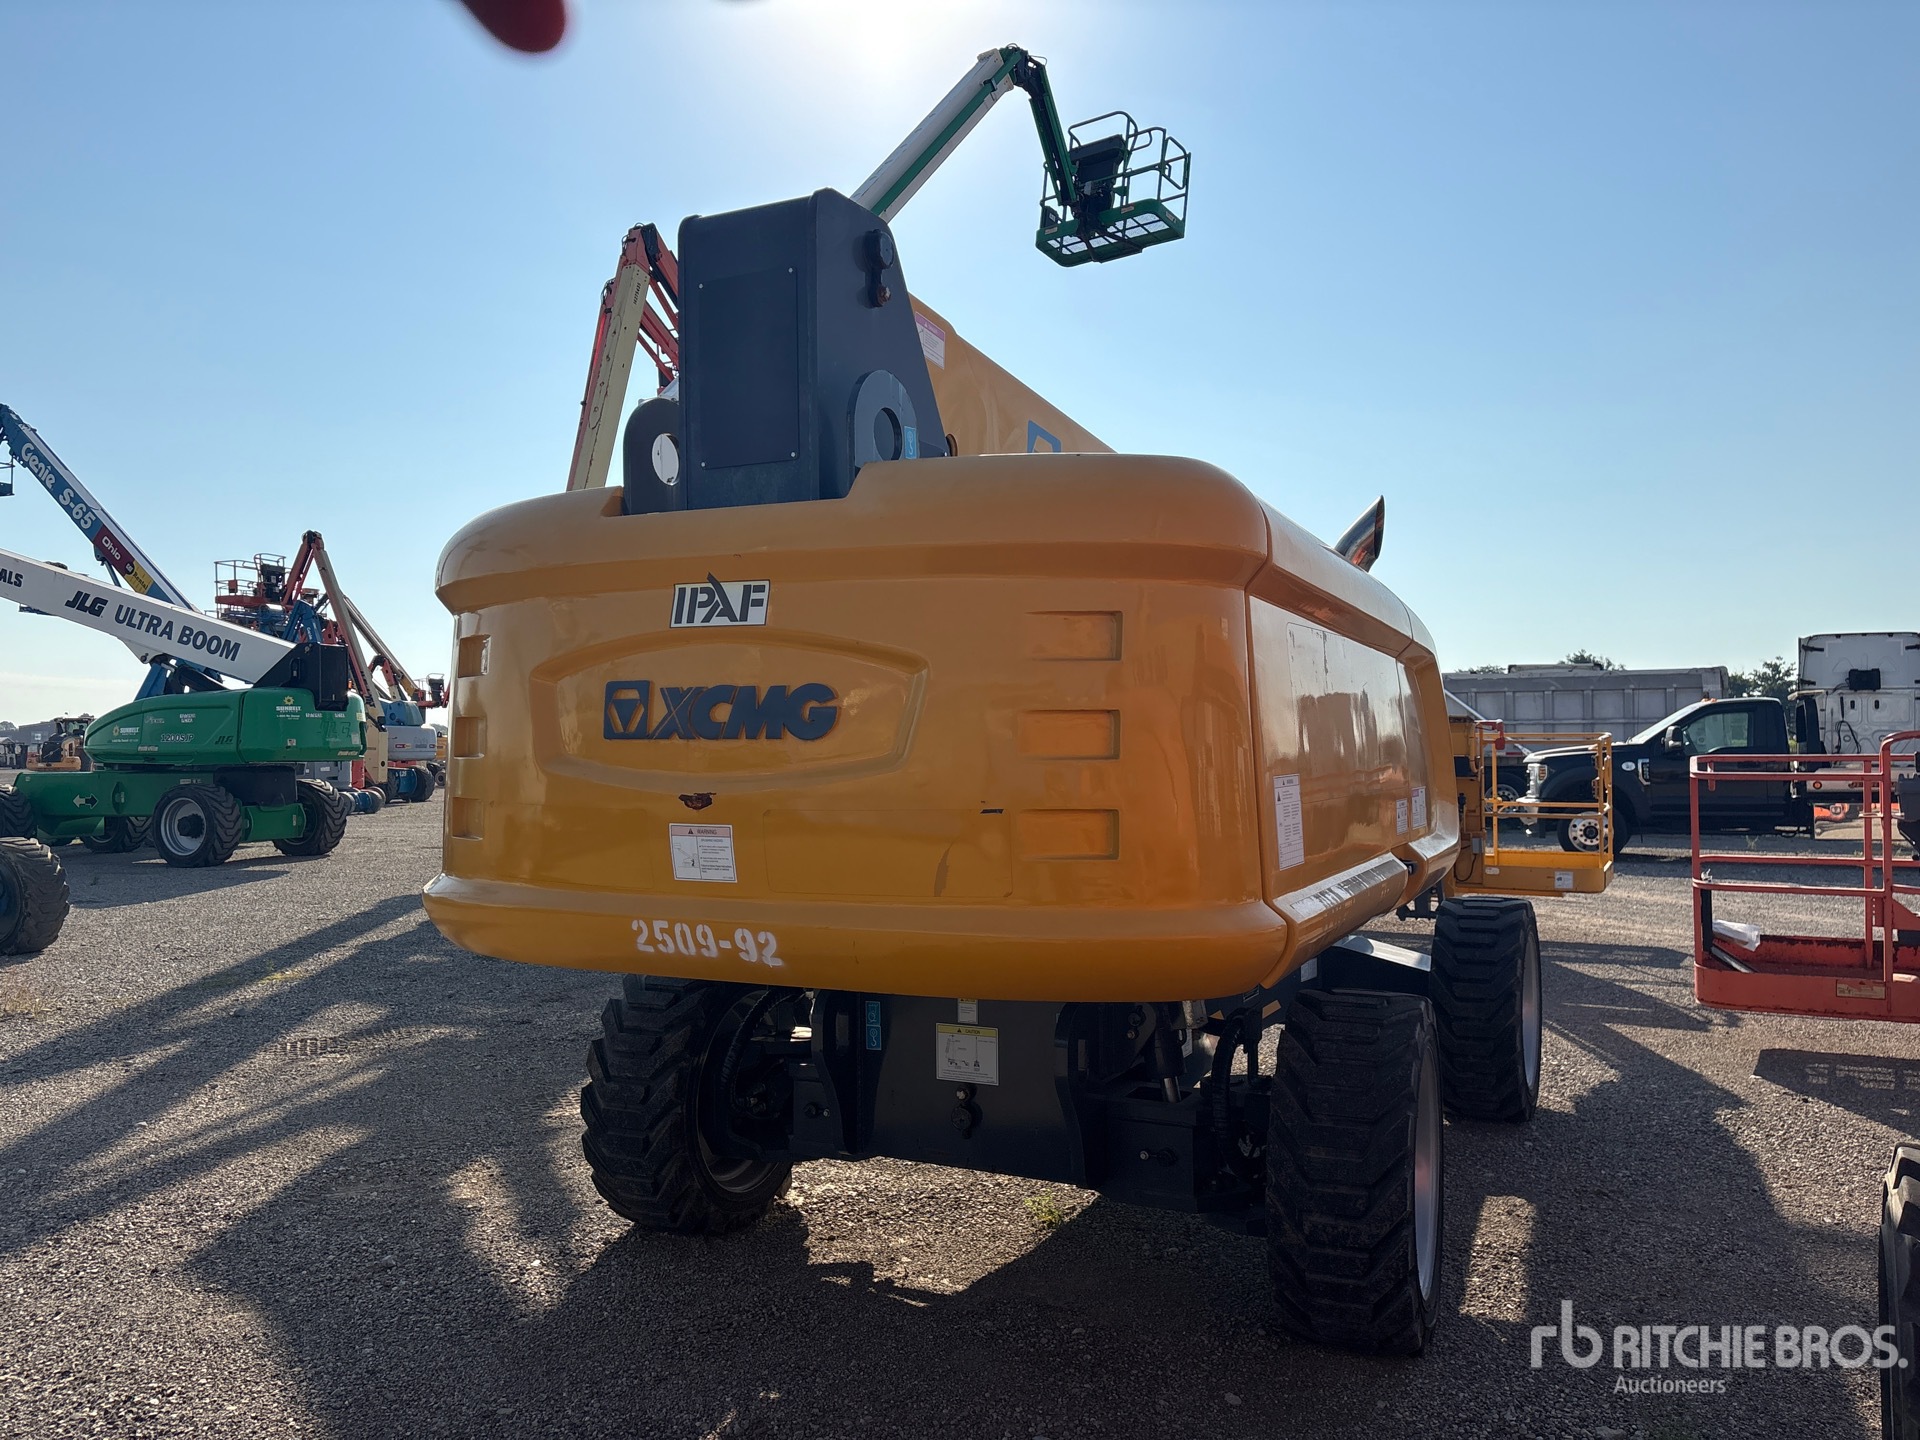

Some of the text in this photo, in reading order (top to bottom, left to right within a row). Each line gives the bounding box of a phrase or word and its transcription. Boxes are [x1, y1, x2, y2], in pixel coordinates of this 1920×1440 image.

[21, 442, 96, 529] Genie S-65
[101, 536, 121, 561] Ohio
[132, 571, 149, 591] Rental
[673, 572, 767, 625] IPAF
[65, 590, 241, 662] JLG ULTRA BOOM
[645, 682, 838, 741] XCMG
[160, 733, 195, 743] 1200SJP
[631, 919, 785, 968] 2509-92
